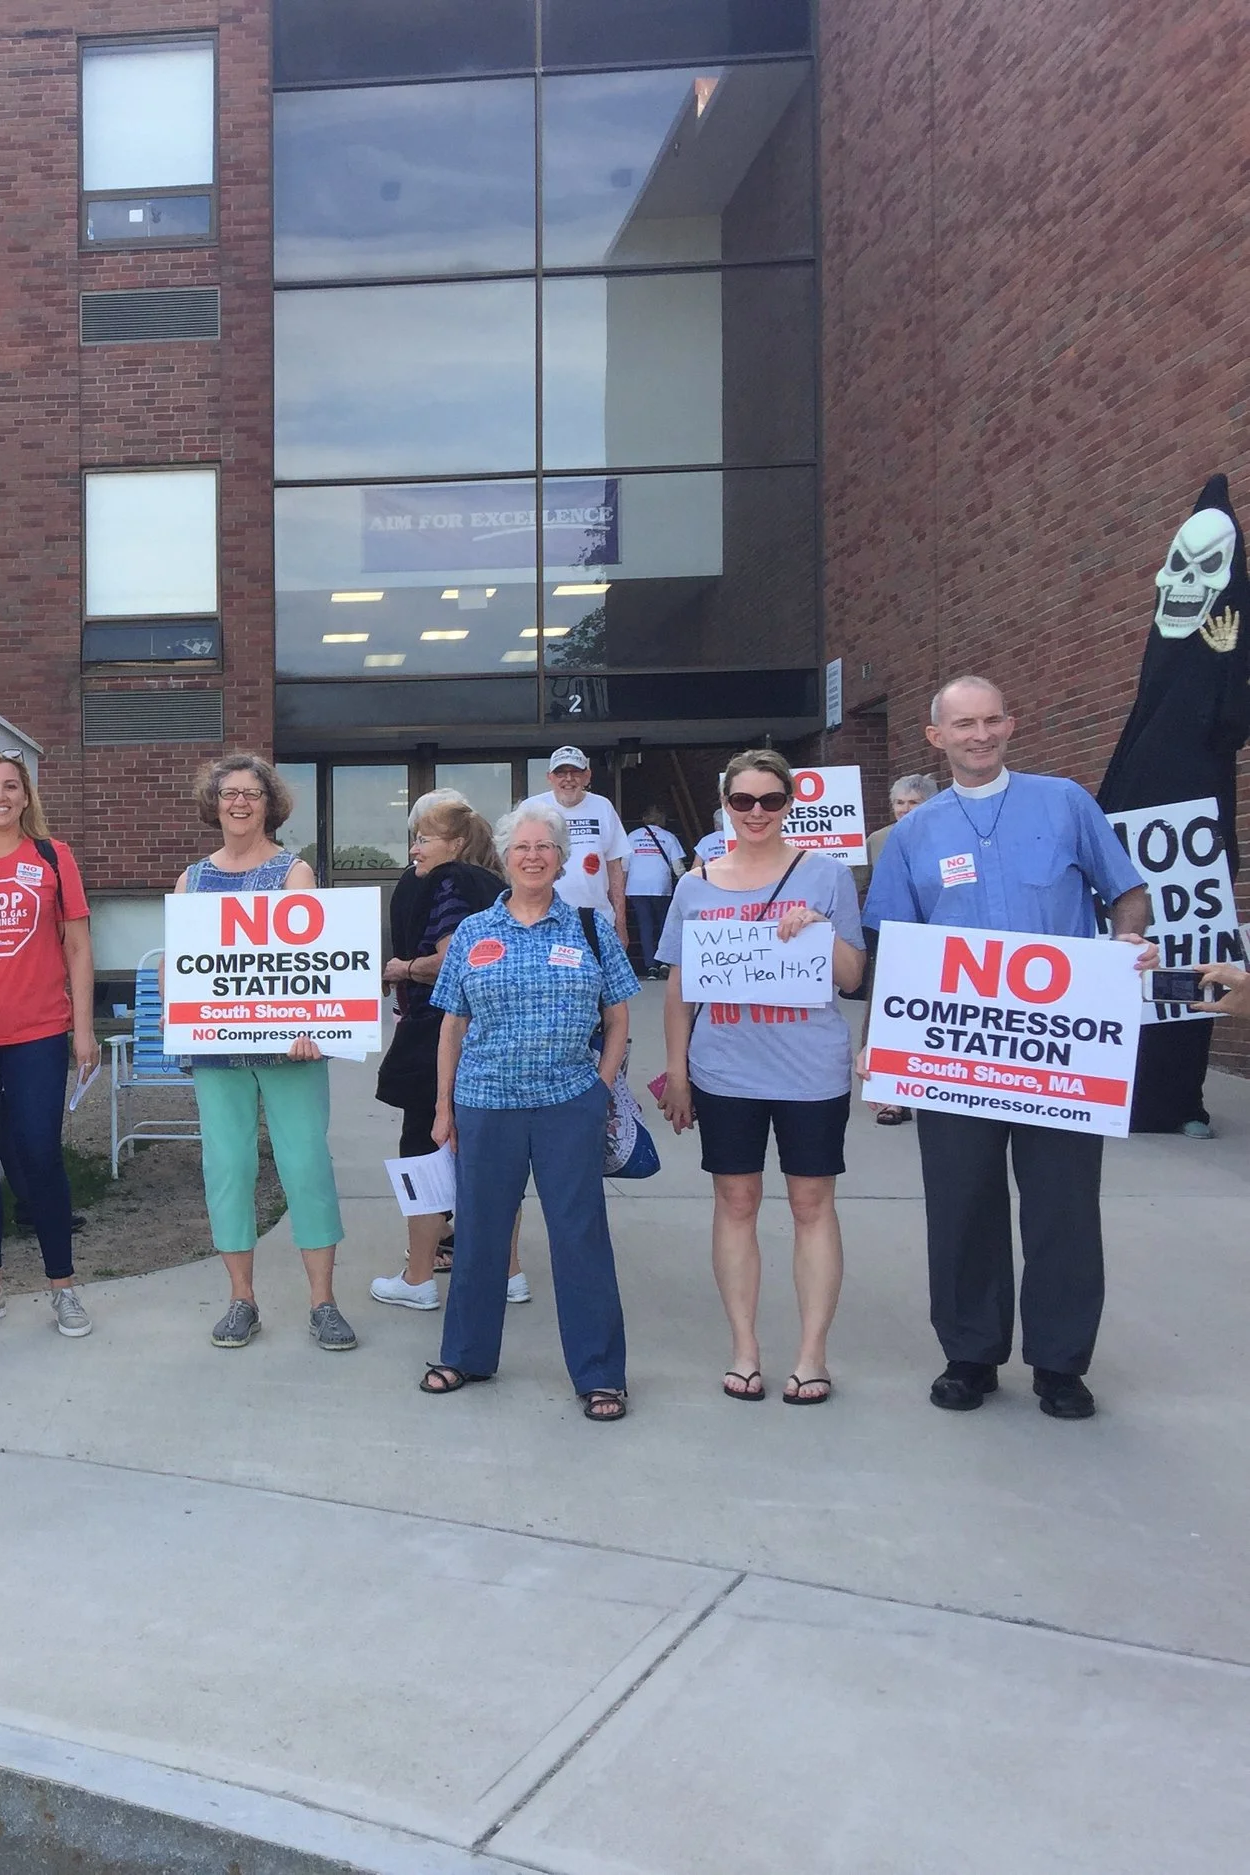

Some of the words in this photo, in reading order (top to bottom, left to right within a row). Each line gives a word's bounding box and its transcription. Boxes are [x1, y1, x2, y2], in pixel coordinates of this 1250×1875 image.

[368, 515, 412, 532] AIM
[419, 513, 463, 530] FOR
[470, 506, 614, 528] EXCELLENCE
[568, 694, 582, 713] 2
[793, 771, 825, 803] O
[785, 804, 856, 820] RESSOR
[781, 820, 832, 833] ATION
[823, 836, 843, 846] MA
[23, 864, 38, 872] NO
[947, 857, 966, 868] NO
[10, 909, 28, 917] GAS
[221, 894, 325, 947] NO
[694, 925, 778, 946] WHAT
[176, 951, 370, 975] COMPRESSOR
[701, 948, 772, 968] ABOUT
[744, 956, 827, 982] Health?
[940, 935, 1072, 1005] NO
[212, 975, 331, 997] STATION
[200, 1005, 250, 1020] South
[255, 1004, 311, 1020] Shore,
[316, 1003, 345, 1018] MA
[884, 995, 1123, 1045] COMPRESSOR
[192, 1028, 352, 1043] NOCompressor.com
[925, 1026, 1071, 1066] STATION
[907, 1056, 968, 1080] South
[973, 1066, 1042, 1093] Shore,
[1048, 1075, 1085, 1096] MA
[896, 1081, 1091, 1122] NOCompressor.com
